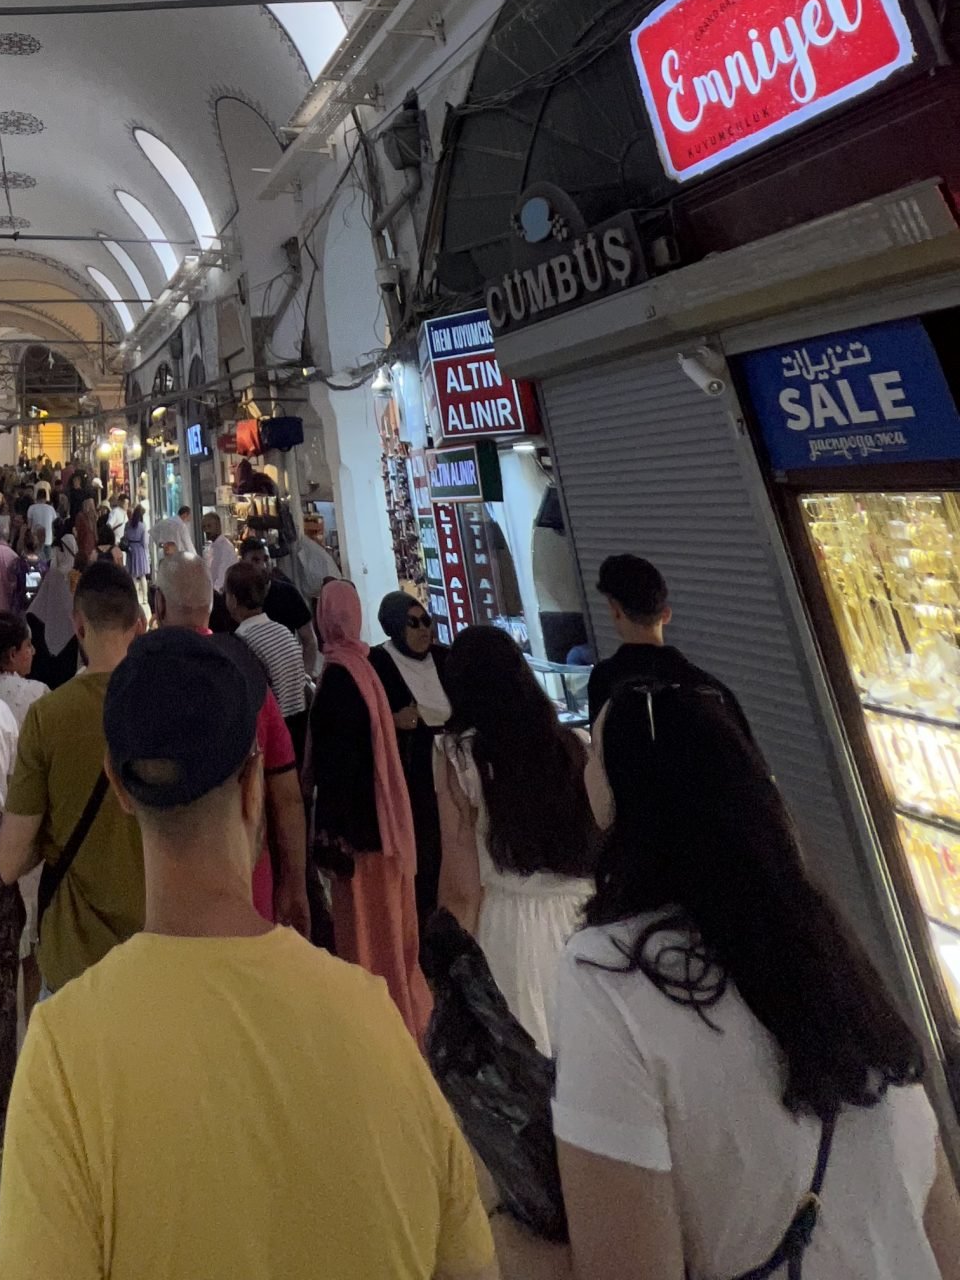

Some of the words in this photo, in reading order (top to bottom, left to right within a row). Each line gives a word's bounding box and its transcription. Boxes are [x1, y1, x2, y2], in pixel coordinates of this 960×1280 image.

[447, 360, 502, 393] ALTIN
[782, 341, 872, 380] تنزيلات
[448, 398, 515, 431] ALINIR
[779, 371, 916, 431] SALE
